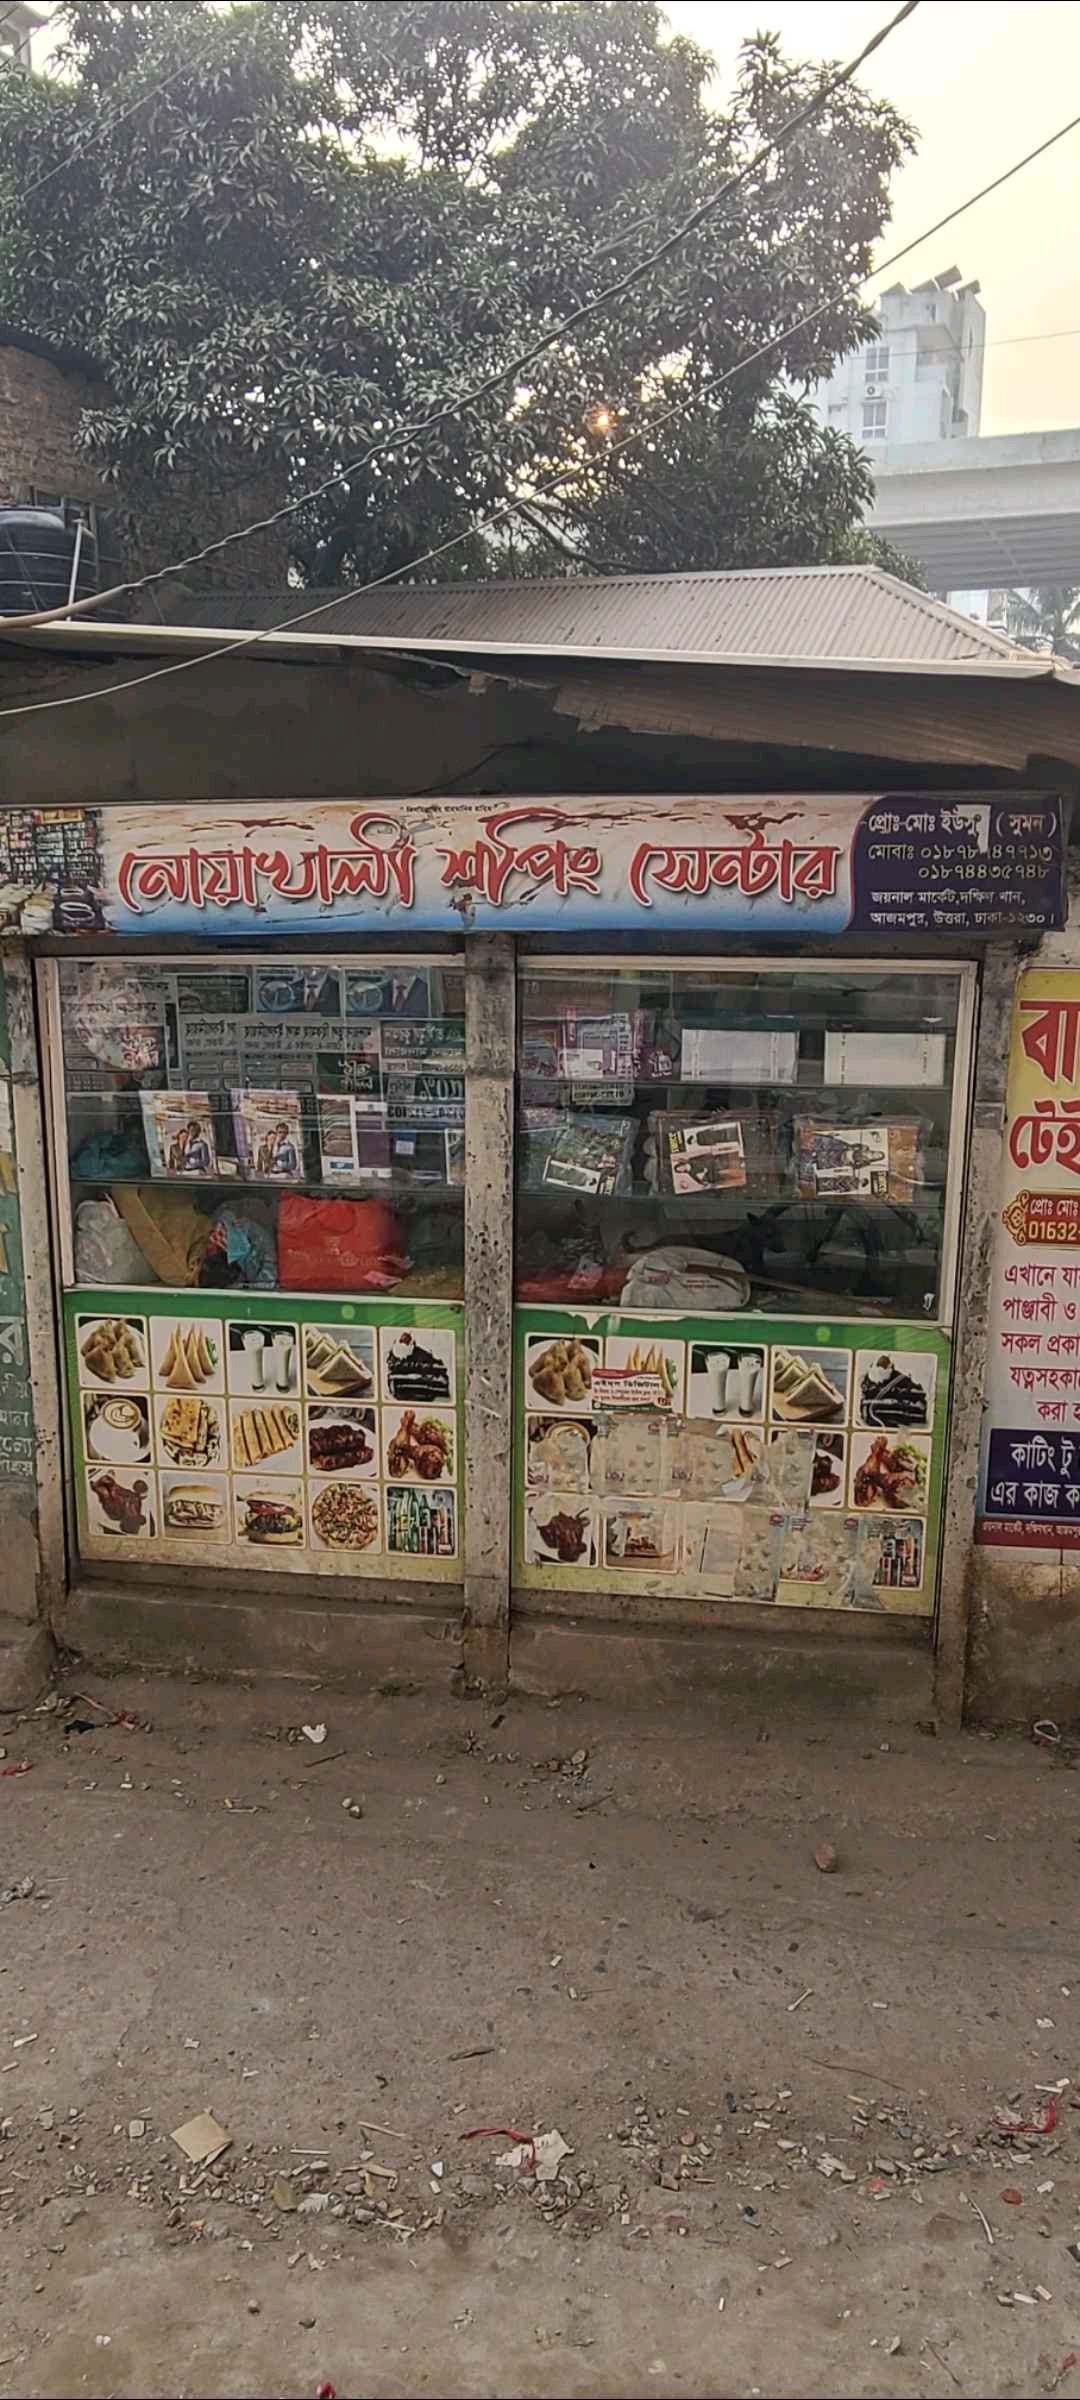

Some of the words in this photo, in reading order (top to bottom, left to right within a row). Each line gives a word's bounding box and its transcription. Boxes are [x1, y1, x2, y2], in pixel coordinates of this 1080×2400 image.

[118, 812, 416, 914] নোয়াখালী
[433, 806, 602, 905] শপিং
[629, 822, 843, 907] সেন্টার
[1004, 1263, 1057, 1287] এখানে
[1061, 1265, 1080, 1288] যা
[1002, 1292, 1058, 1321] পাঞ্জাবী
[1063, 1302, 1076, 1321] ও
[1000, 1332, 1042, 1355] সকল
[1009, 1366, 1080, 1392] যত্নসহকা
[1036, 1400, 1068, 1424] করা
[1009, 1435, 1056, 1472] কাটিং
[991, 1481, 1020, 1506] এর
[1022, 1481, 1061, 1508] কাজ
